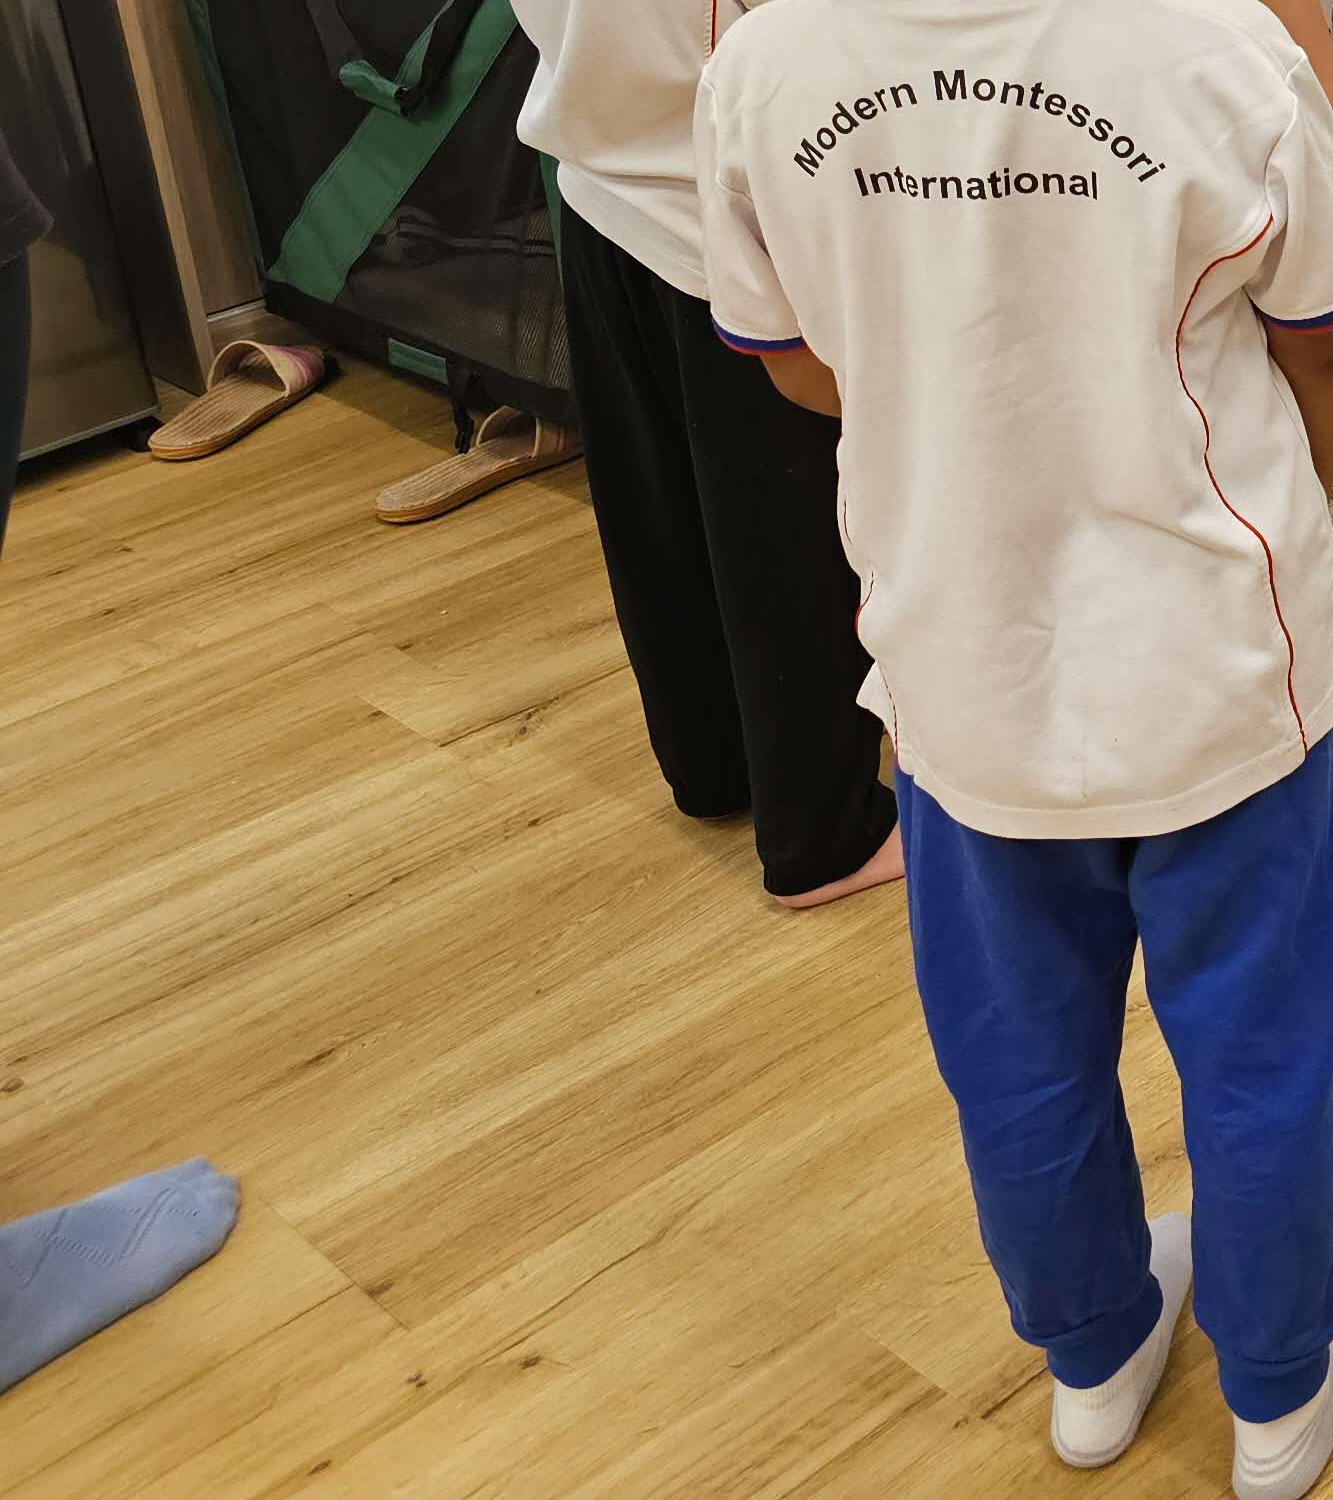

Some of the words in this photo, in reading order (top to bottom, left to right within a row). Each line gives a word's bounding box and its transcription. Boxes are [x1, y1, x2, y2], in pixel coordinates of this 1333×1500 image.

[793, 82, 918, 178] Modern
[932, 69, 1166, 182] Montessori
[853, 166, 1098, 200] International
